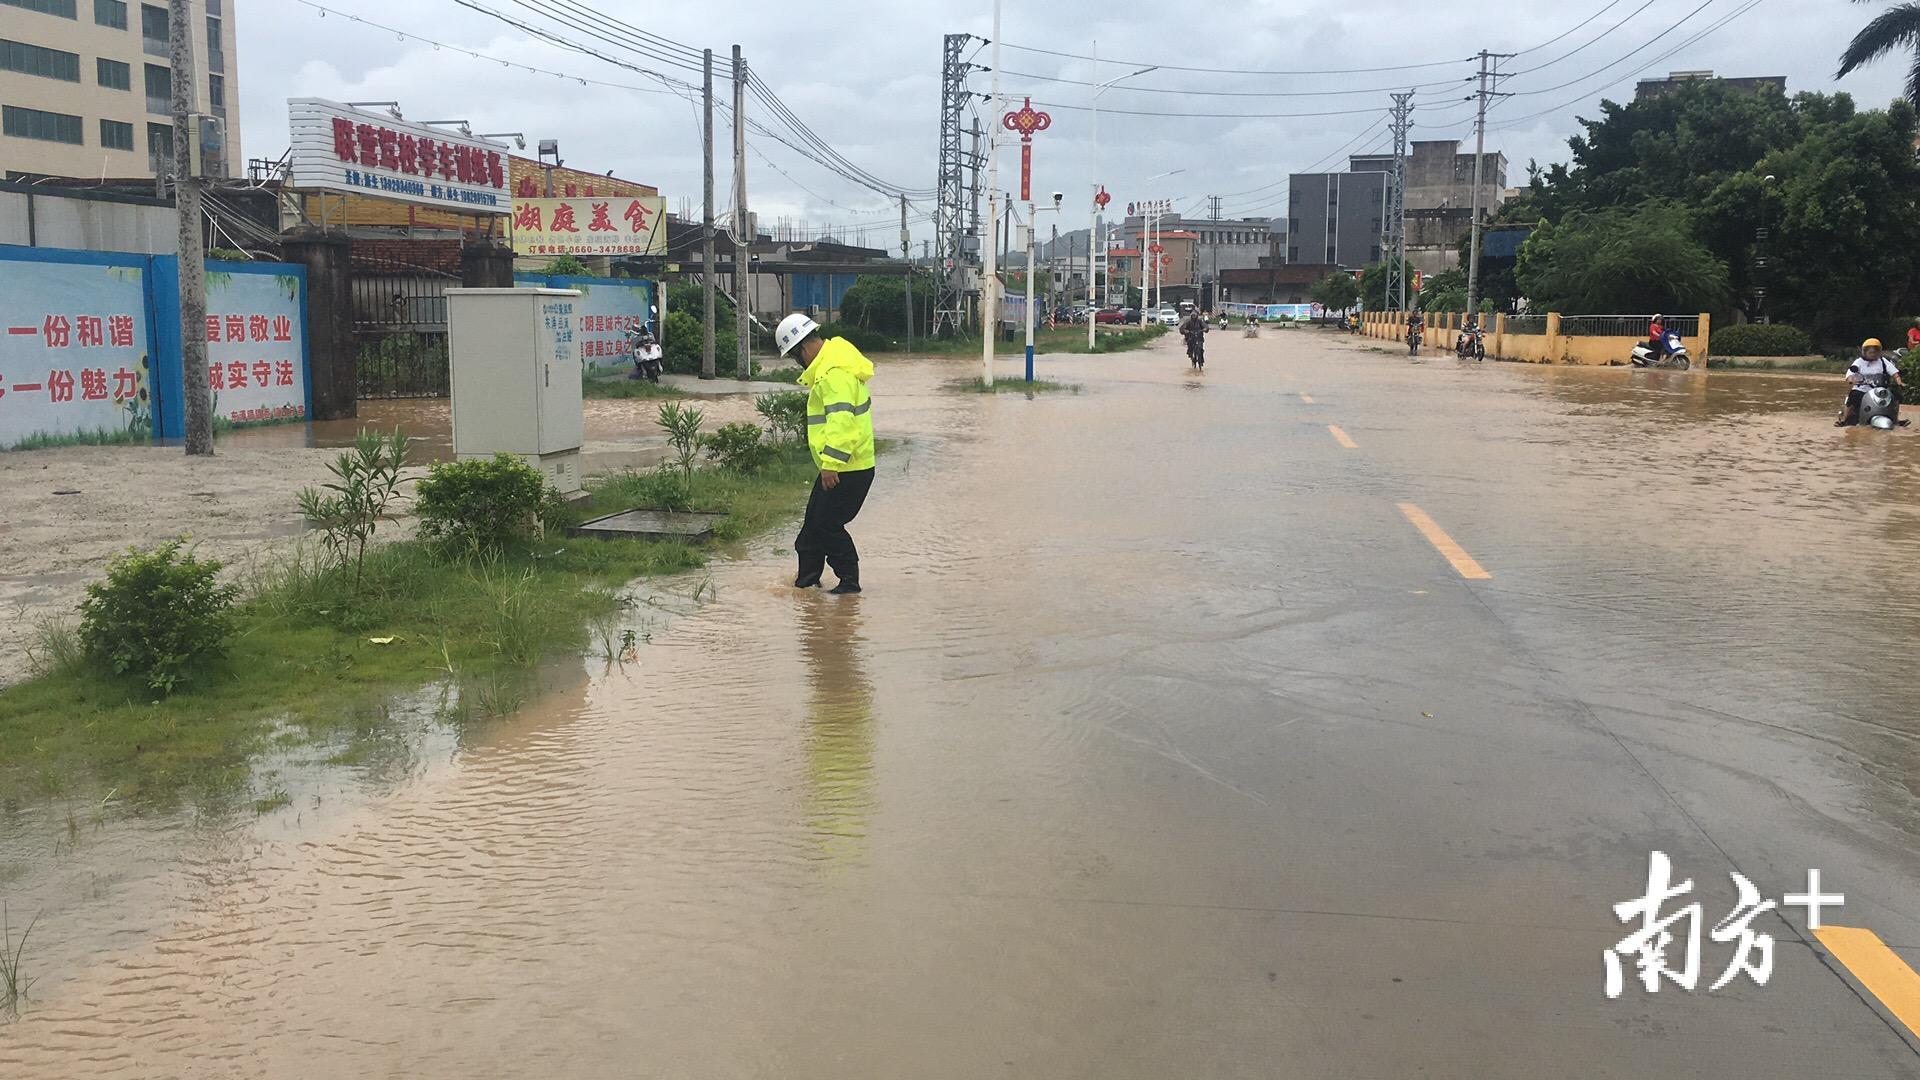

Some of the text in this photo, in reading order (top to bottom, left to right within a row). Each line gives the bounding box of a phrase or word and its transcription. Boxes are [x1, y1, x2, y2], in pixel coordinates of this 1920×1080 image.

[332, 117, 503, 189] 联营驾校学车训练场
[513, 200, 653, 233] 湖庭美食
[581, 340, 633, 358] 德是立身之
[0, 368, 137, 402] 一份魅力
